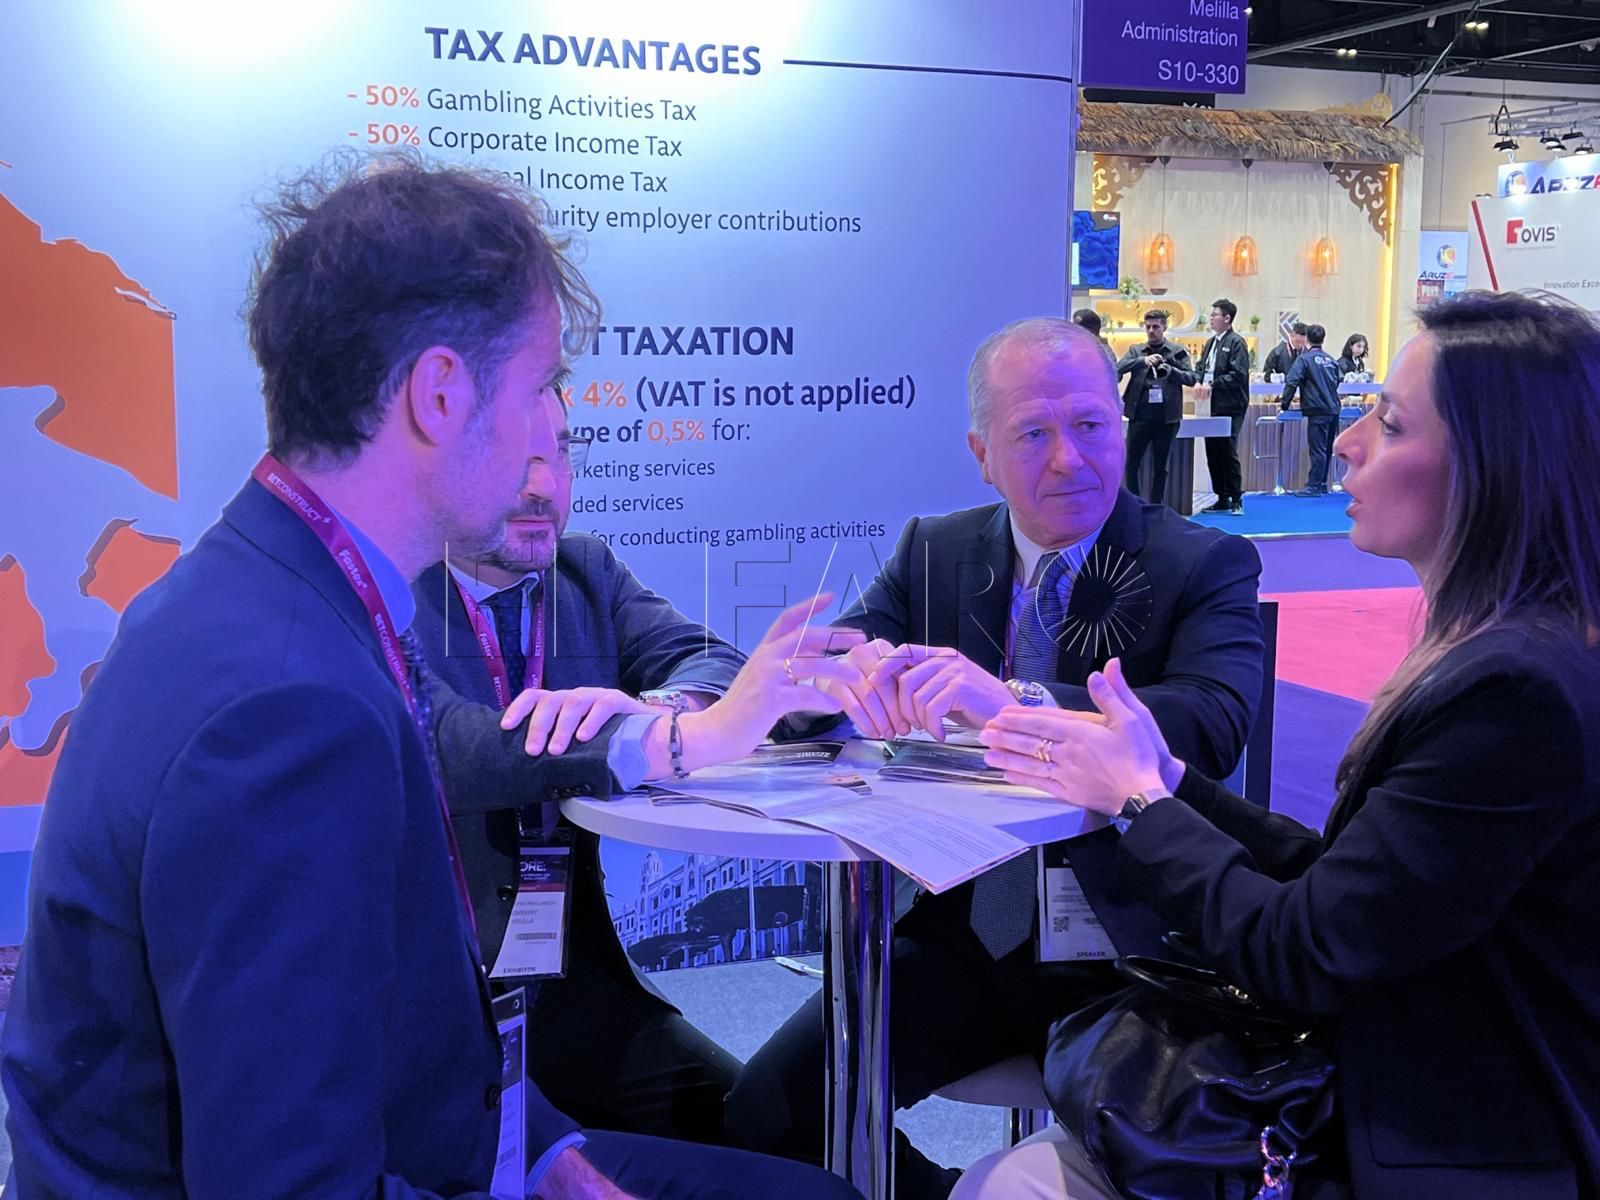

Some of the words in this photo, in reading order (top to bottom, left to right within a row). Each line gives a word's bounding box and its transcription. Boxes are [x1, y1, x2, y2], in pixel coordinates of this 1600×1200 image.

[1189, 0, 1240, 20] Melilla
[1121, 20, 1239, 47] Administration
[425, 27, 505, 63] TAX
[511, 33, 762, 75] ADVANTAGES
[1158, 59, 1239, 85] S10-330
[366, 85, 419, 108] 50%
[427, 88, 542, 120] Gambling
[548, 94, 655, 120] Activities
[659, 99, 697, 121] Tax
[367, 123, 420, 146] 50%
[428, 126, 547, 155] Corporate
[555, 131, 639, 156] Income
[645, 136, 683, 156] Tax
[540, 168, 624, 192] Income
[630, 172, 667, 192] Tax
[550, 204, 600, 232] urity
[606, 207, 713, 235] employer
[718, 209, 862, 233] contributions
[613, 326, 794, 356] TAXATION
[582, 381, 627, 408] 4%
[636, 375, 706, 413] (VAT
[714, 378, 735, 407] is
[744, 381, 795, 407] not
[801, 374, 916, 412] applied)
[616, 418, 643, 442] of
[647, 419, 706, 445] 0,5%
[712, 417, 751, 441] for:
[644, 458, 716, 477] services
[572, 494, 607, 513] ded
[612, 493, 684, 512] services
[620, 525, 721, 549] conducting
[725, 522, 807, 547] gambling
[811, 520, 885, 541] activities
